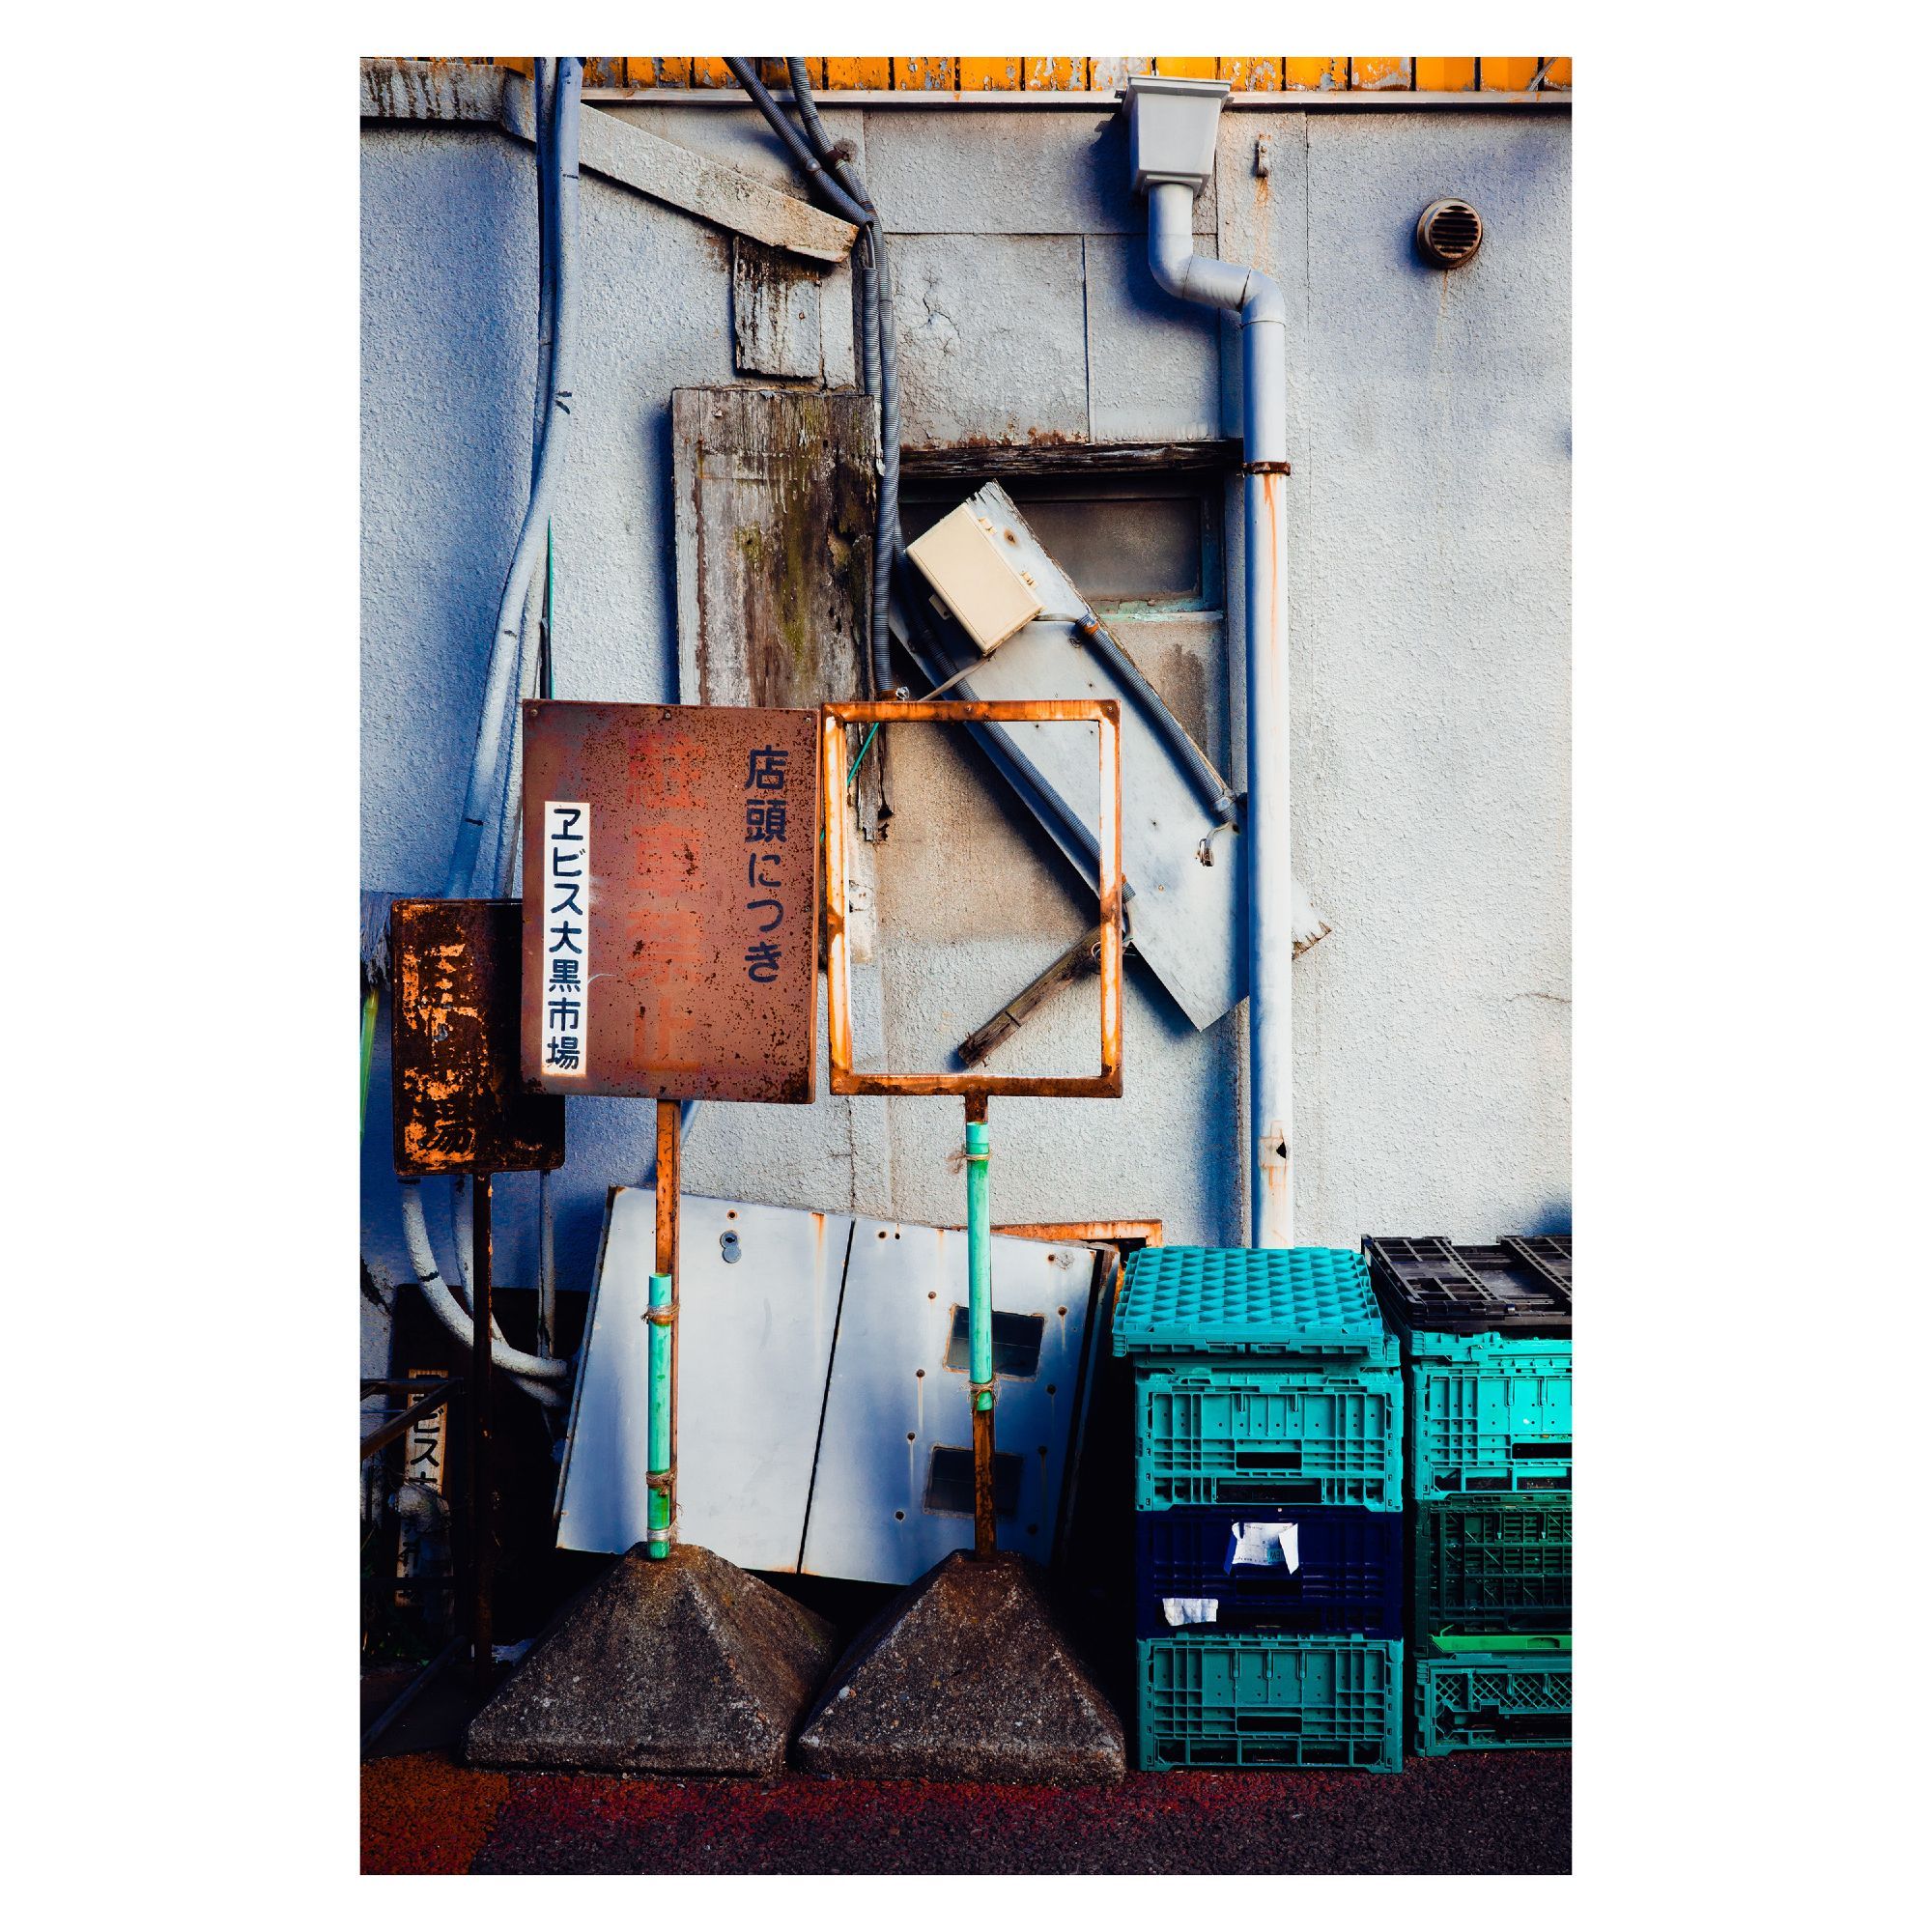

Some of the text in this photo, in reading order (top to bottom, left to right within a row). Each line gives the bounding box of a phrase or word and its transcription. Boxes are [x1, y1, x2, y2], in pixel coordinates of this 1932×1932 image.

[546, 809, 585, 1070] ヱビス大黒市場
[743, 743, 789, 984] 店頭につき
